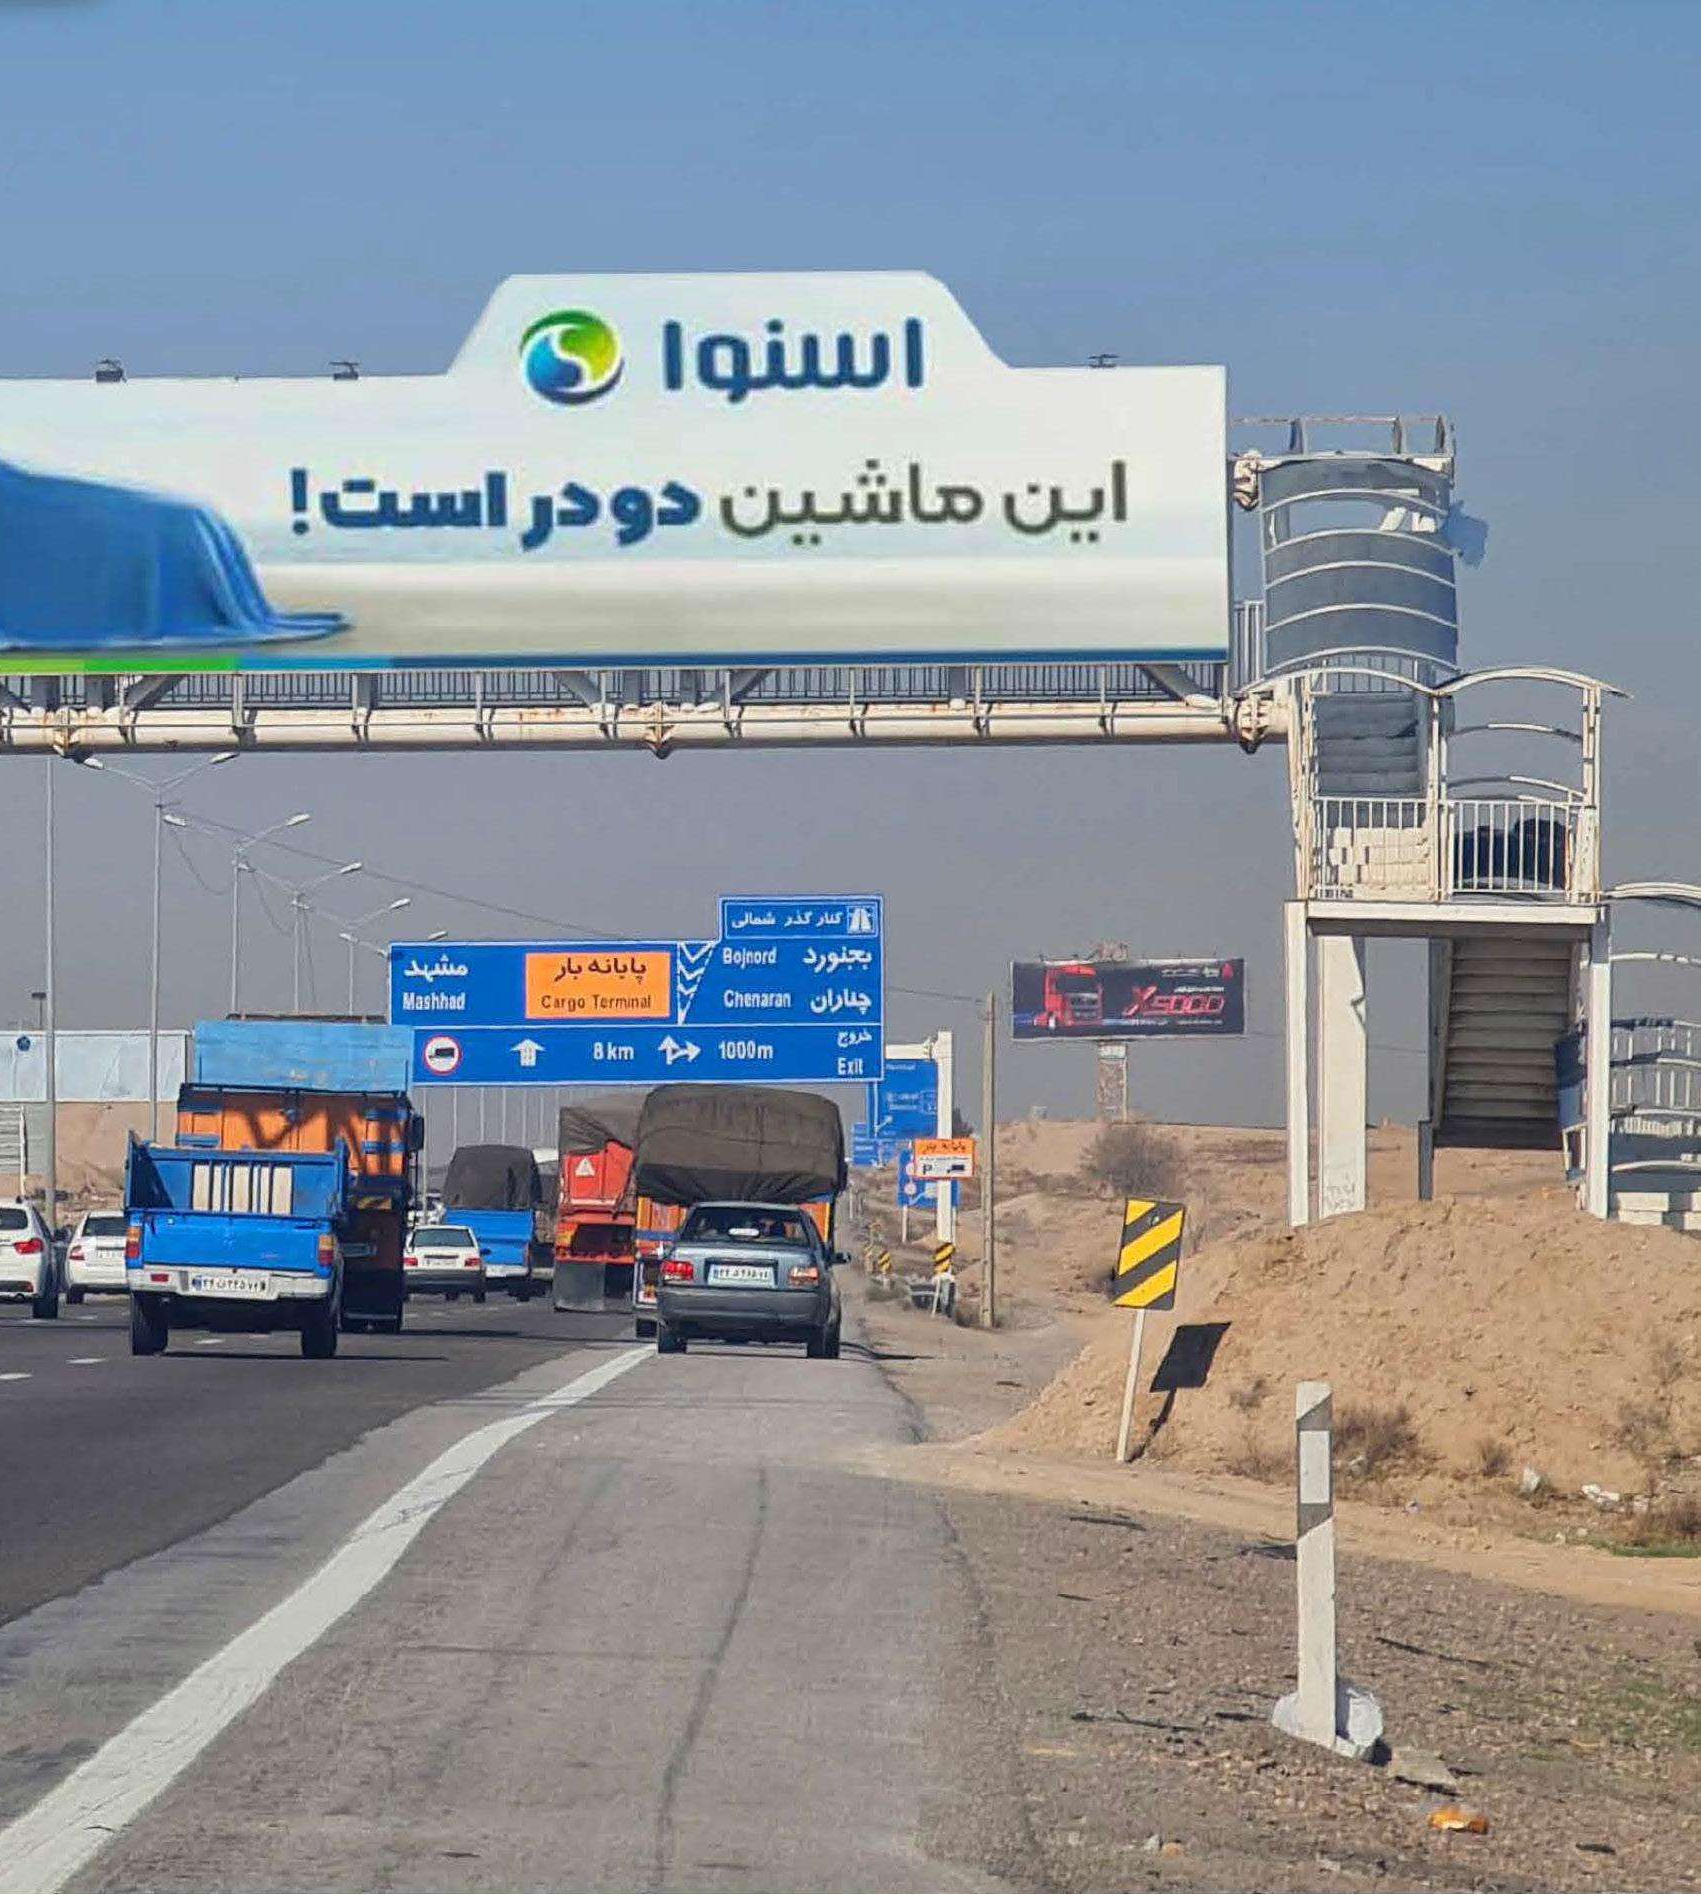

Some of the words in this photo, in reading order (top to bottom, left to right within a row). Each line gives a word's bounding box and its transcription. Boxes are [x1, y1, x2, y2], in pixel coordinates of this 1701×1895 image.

[662, 317, 924, 403] اسنوا
[720, 458, 985, 546] ماشین
[1003, 460, 1127, 543] این
[731, 911, 777, 929] شمالی
[783, 910, 814, 928] گذر
[816, 911, 844, 928] کنار
[403, 952, 469, 983] مشهد
[554, 956, 584, 982] بار
[722, 946, 778, 970] Bojnord
[802, 945, 873, 974] بجنورد
[588, 956, 648, 985] پایانه
[402, 992, 467, 1011] Mashhad
[541, 994, 587, 1010] Cargo
[593, 994, 652, 1010] Terminal
[723, 989, 792, 1009] Chenaran
[809, 987, 873, 1015] چناران
[836, 1029, 873, 1048] خروج
[836, 1057, 864, 1076] Exit
